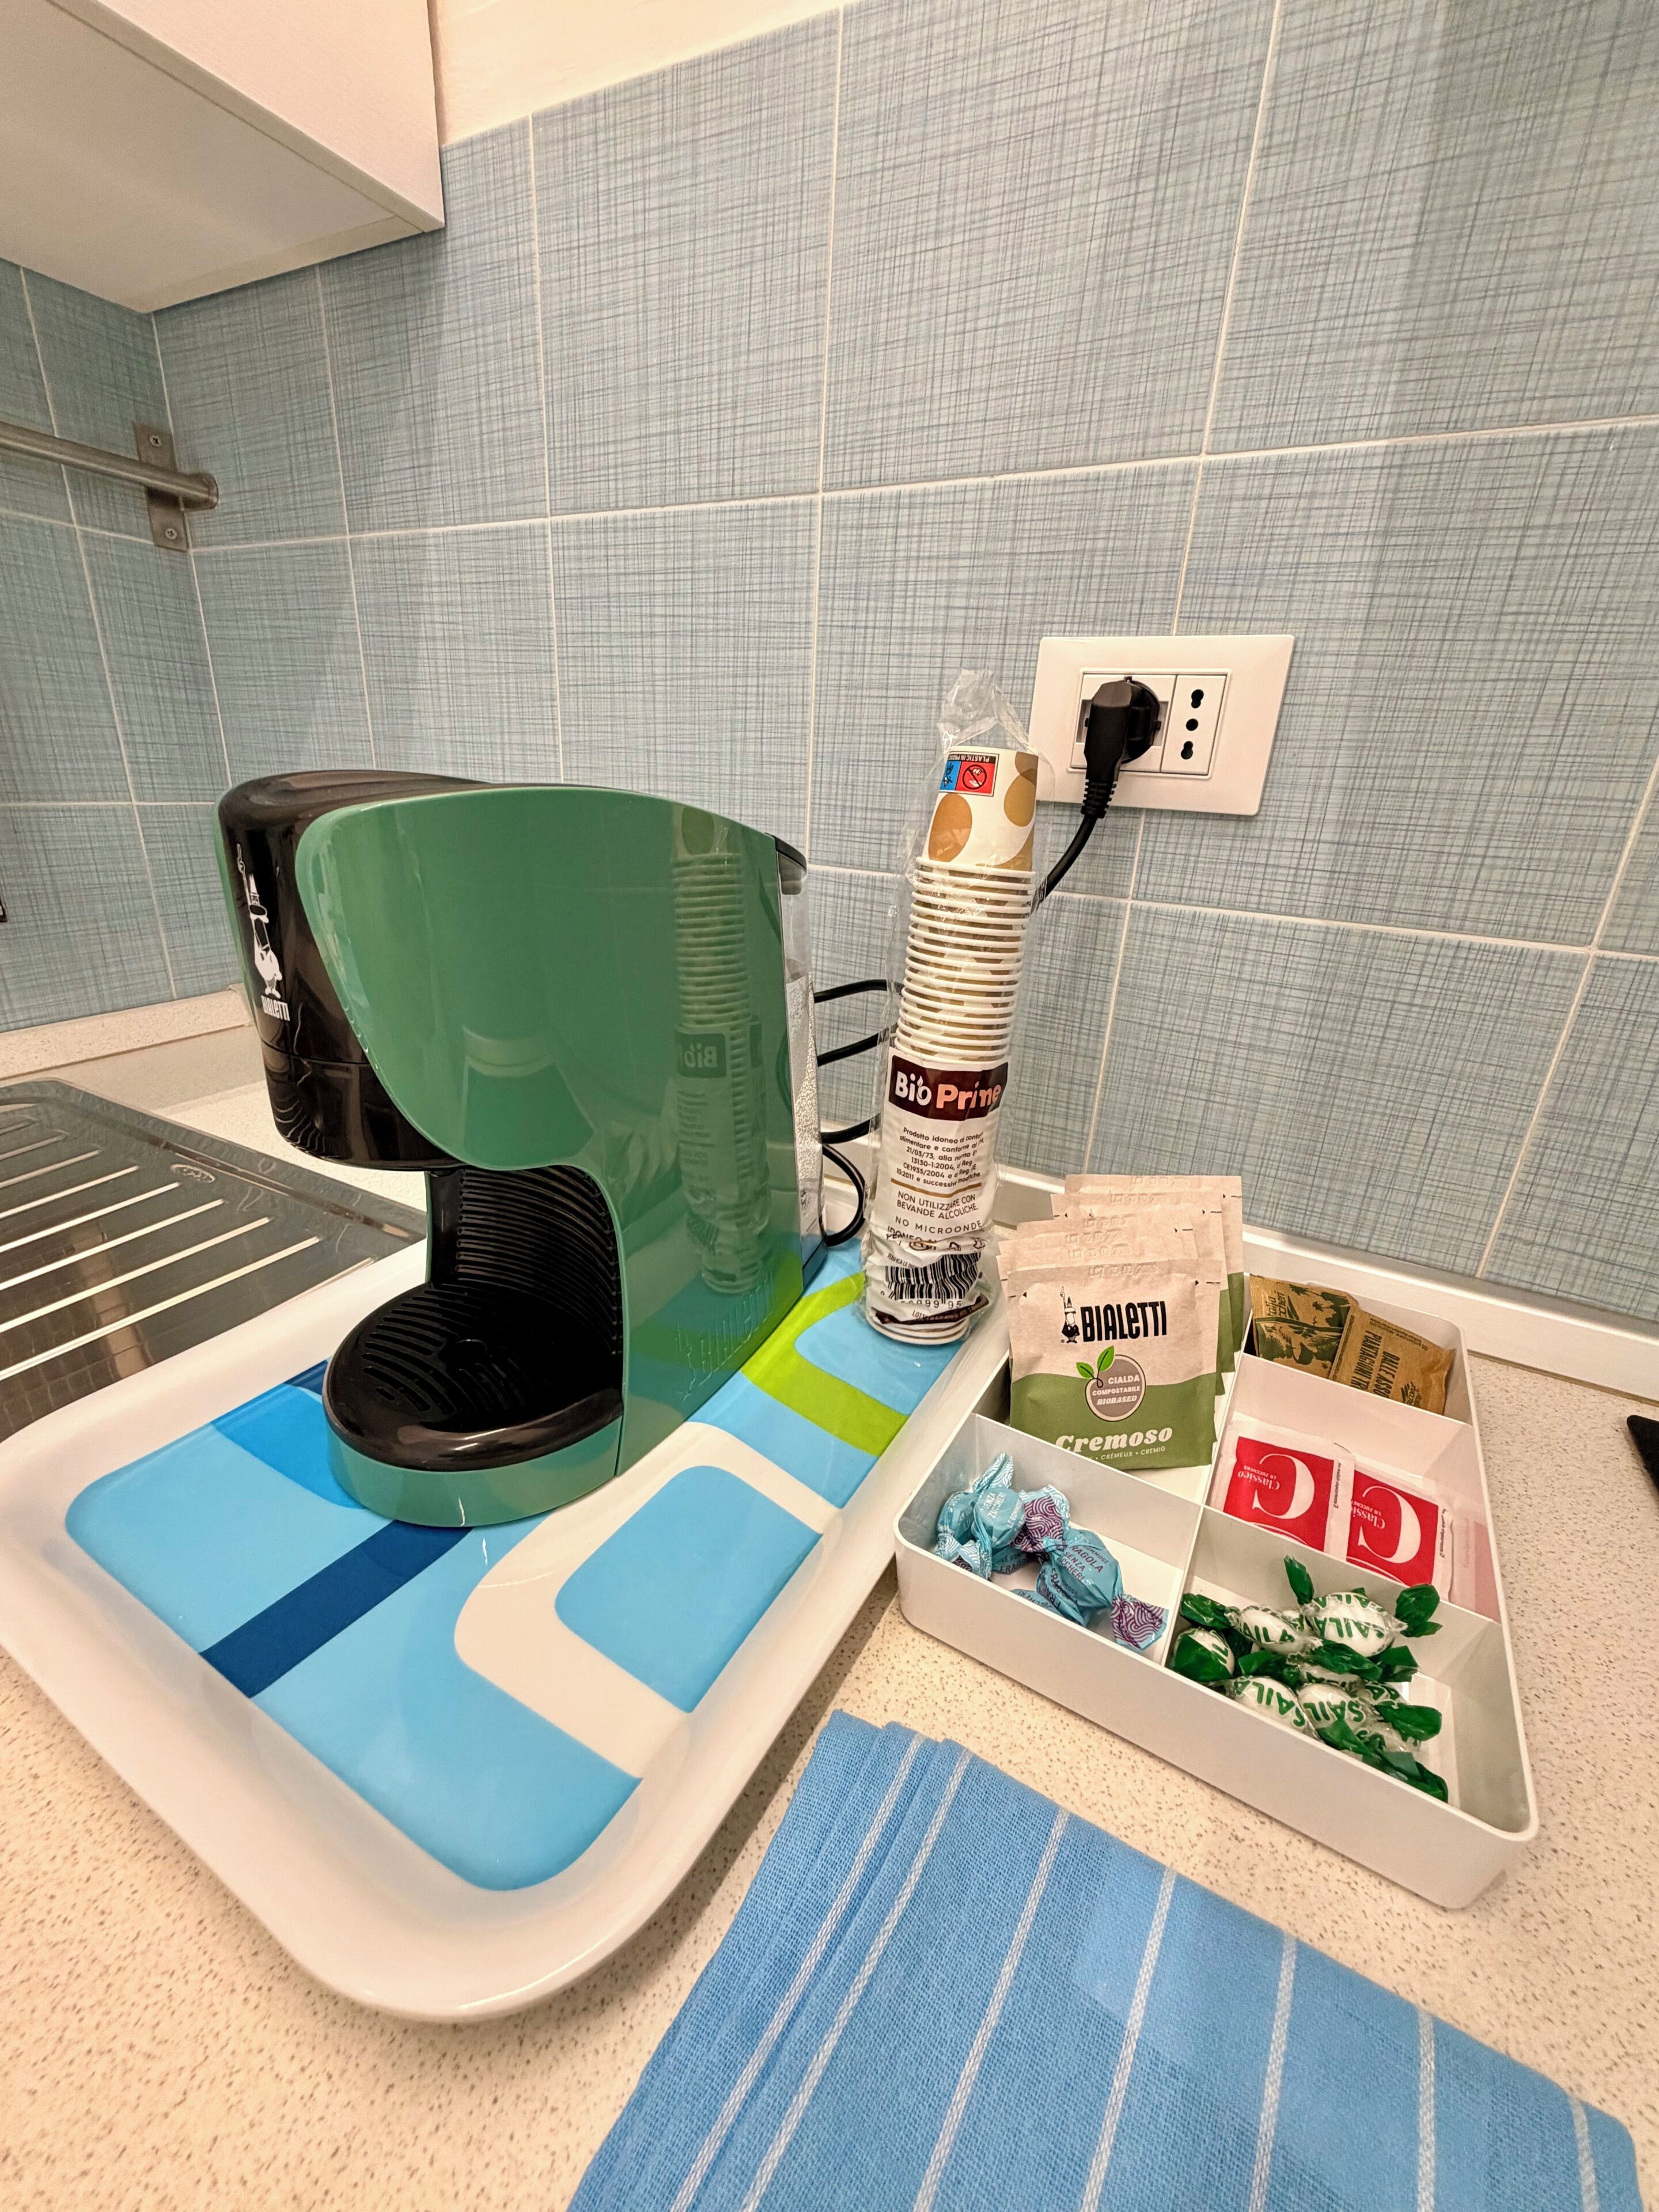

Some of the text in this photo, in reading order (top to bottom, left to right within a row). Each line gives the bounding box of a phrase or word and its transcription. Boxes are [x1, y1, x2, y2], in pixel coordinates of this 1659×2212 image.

[261, 995, 290, 1021] BIALETTI
[895, 1071, 1002, 1110] Bio Prime
[899, 1135, 931, 1150] alimentare
[903, 1127, 929, 1141] Prodotto
[932, 1135, 958, 1144] idoneo
[906, 1146, 935, 1160] 21/03/73,
[903, 1162, 945, 1178] CE1935/2004
[897, 1199, 935, 1218] BEVANDE
[898, 1191, 976, 1211] NON UTILIZZARE CON
[895, 1216, 909, 1226] NO
[1080, 1301, 1167, 1343] BIALETTI
[1354, 1330, 1382, 1380] PIANTAGIONI
[1378, 1351, 1400, 1378] DALLE
[1108, 1374, 1140, 1384] CIALDA
[1092, 1385, 1141, 1396] COMPOSTABILE
[1097, 1395, 1138, 1406] BIOBASED
[1055, 1427, 1173, 1453] Cremoso
[1101, 1445, 1166, 1460] CRÉMEUX CREMIG
[1238, 1470, 1280, 1490] Classico
[1243, 1465, 1269, 1477] ZUCCHERO
[1252, 1453, 1315, 1519] C
[1358, 1486, 1421, 1564] C
[1063, 1552, 1085, 1571] SENZA
[1234, 1680, 1306, 1727] SAILA
[1303, 1700, 1364, 1722] SAIL
